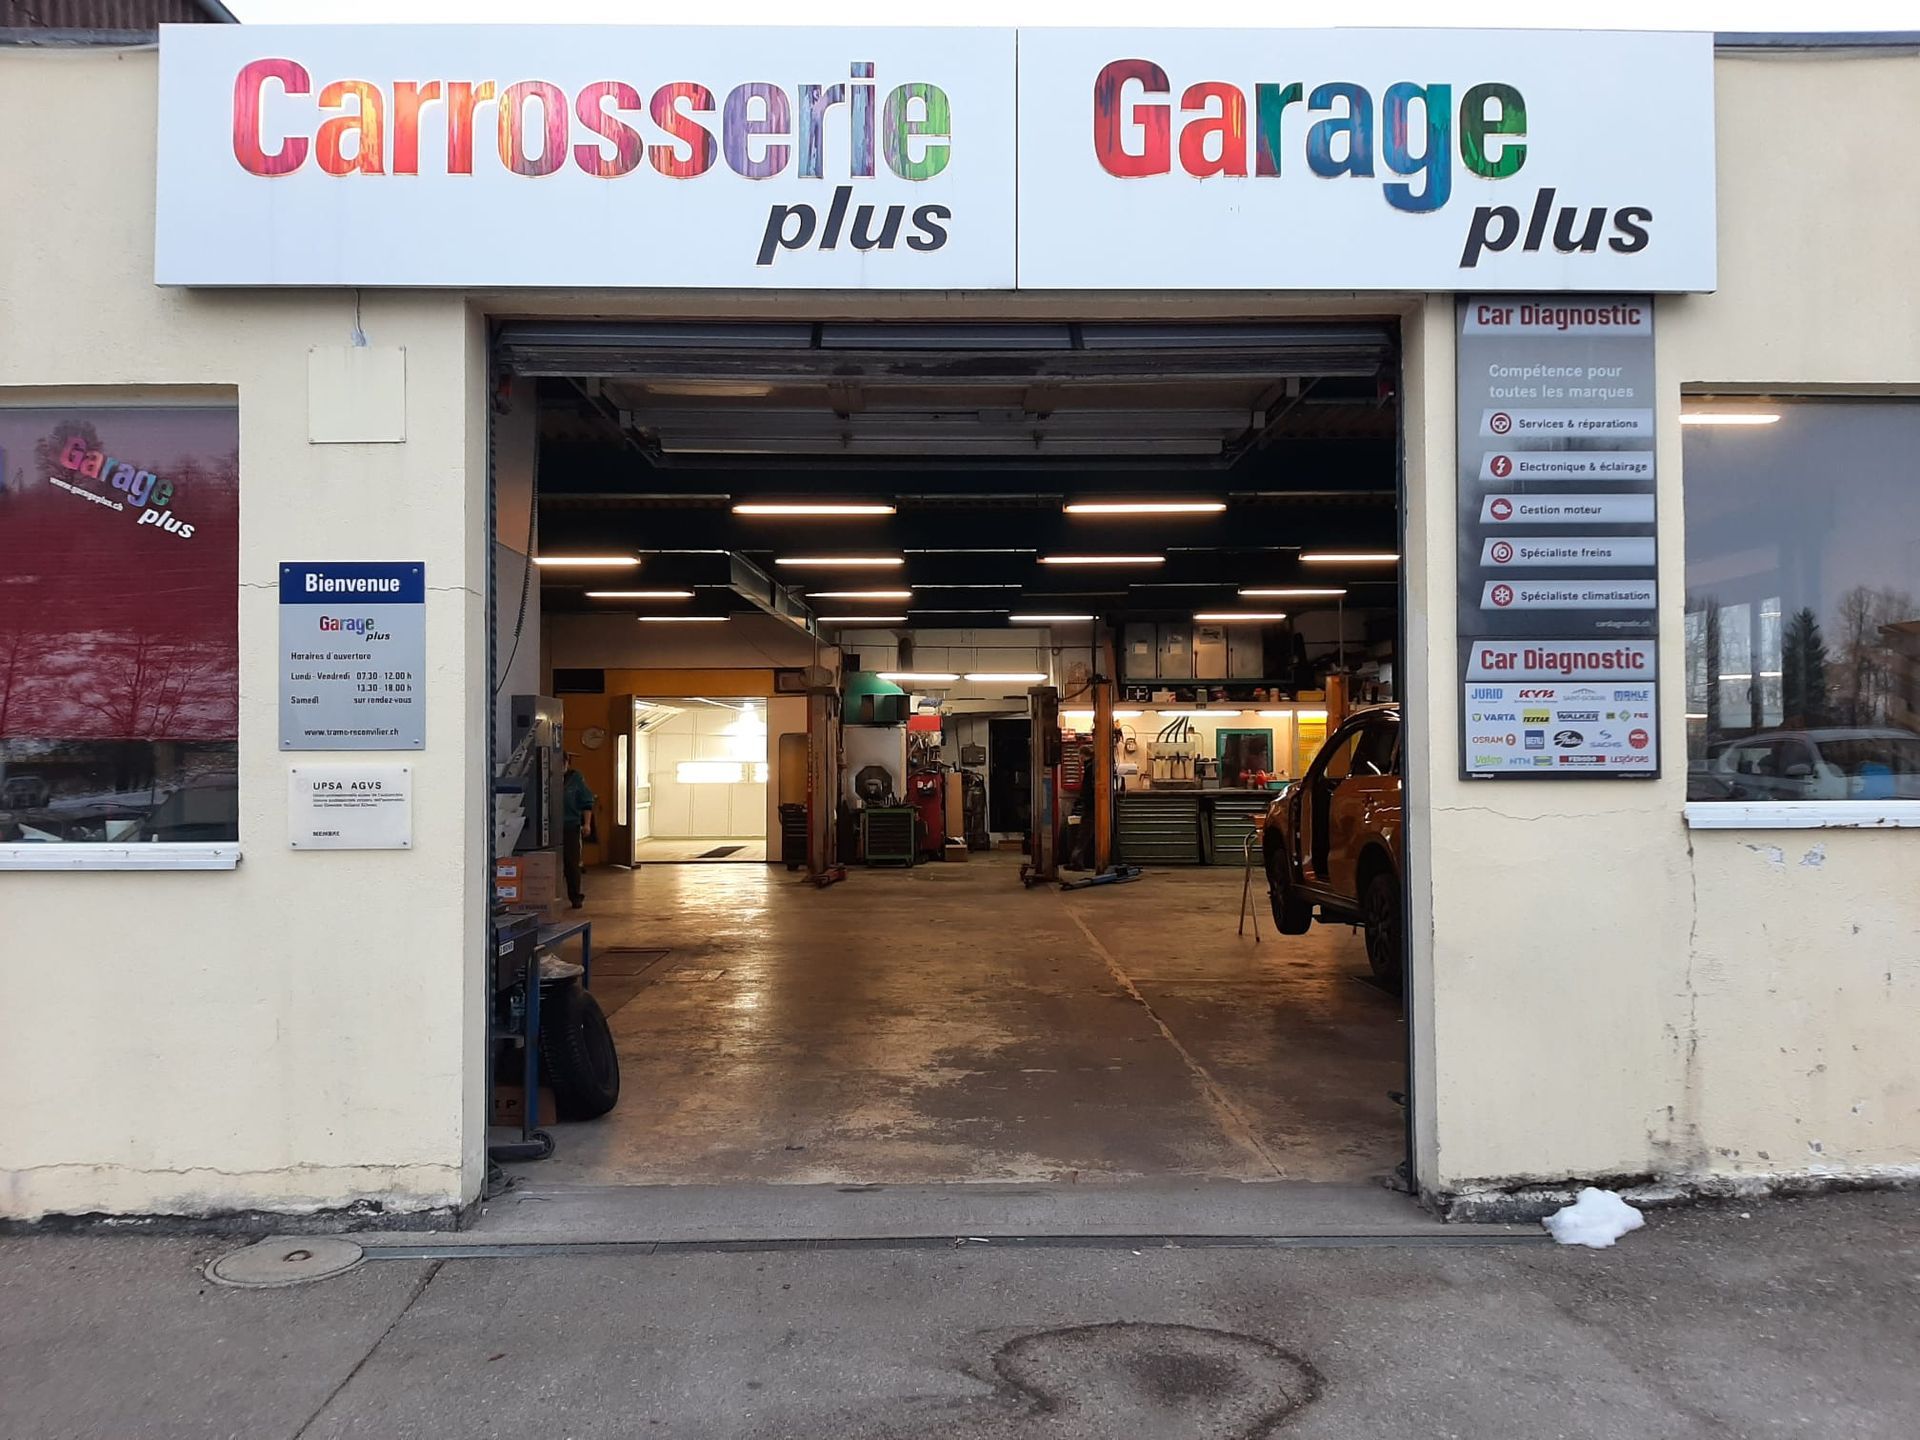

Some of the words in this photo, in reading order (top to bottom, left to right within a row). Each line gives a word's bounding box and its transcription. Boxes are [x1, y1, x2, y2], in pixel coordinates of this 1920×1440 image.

[233, 58, 951, 179] Carrosserie
[1093, 58, 1527, 212] Garage
[756, 186, 951, 266] plus
[1459, 187, 1652, 268] plus
[1477, 305, 1513, 325] Car
[1520, 303, 1641, 330] Diagnostic
[1489, 364, 1582, 379] Compétence
[1588, 366, 1622, 379] pour
[1489, 386, 1537, 398] toutes
[1542, 385, 1564, 398] les
[1569, 387, 1634, 400] marques
[1519, 419, 1563, 429] Services
[1567, 419, 1575, 429] &
[1578, 419, 1638, 431] réparations
[60, 437, 175, 507] Garage
[1520, 462, 1586, 474] Electronique
[1589, 462, 1596, 472] &
[1600, 462, 1647, 474] éclairage
[1520, 505, 1560, 515] Gestion
[1564, 506, 1602, 515] moteur
[137, 508, 195, 539] plus
[1520, 548, 1578, 560] Spécialiste
[1581, 548, 1612, 557] freins
[305, 573, 400, 593] Bienvenue
[1521, 591, 1579, 602] Spécialiste
[1582, 590, 1650, 601] climatisation
[319, 615, 375, 635] Garage
[365, 631, 391, 642] plus
[291, 652, 325, 661] Horaires
[1481, 649, 1517, 669] Car
[1524, 647, 1644, 675] Diagnostic
[291, 672, 312, 680] Lundi
[317, 672, 350, 680] Vendredi
[356, 672, 378, 680] 07.30
[384, 672, 405, 680] 12.00
[407, 672, 412, 680] h
[357, 684, 378, 692] 13.30
[384, 684, 405, 692] 18.00
[407, 684, 412, 692] h
[1471, 688, 1503, 700] JURID
[1519, 689, 1555, 698] KYB
[291, 696, 319, 704] Samedi
[367, 696, 412, 704] rendez-vous
[1483, 713, 1516, 721] VARTA
[1556, 711, 1600, 722] WALKER
[1472, 736, 1504, 744] OSRAM
[313, 782, 343, 790] UPSA
[351, 781, 382, 790] AGVS
